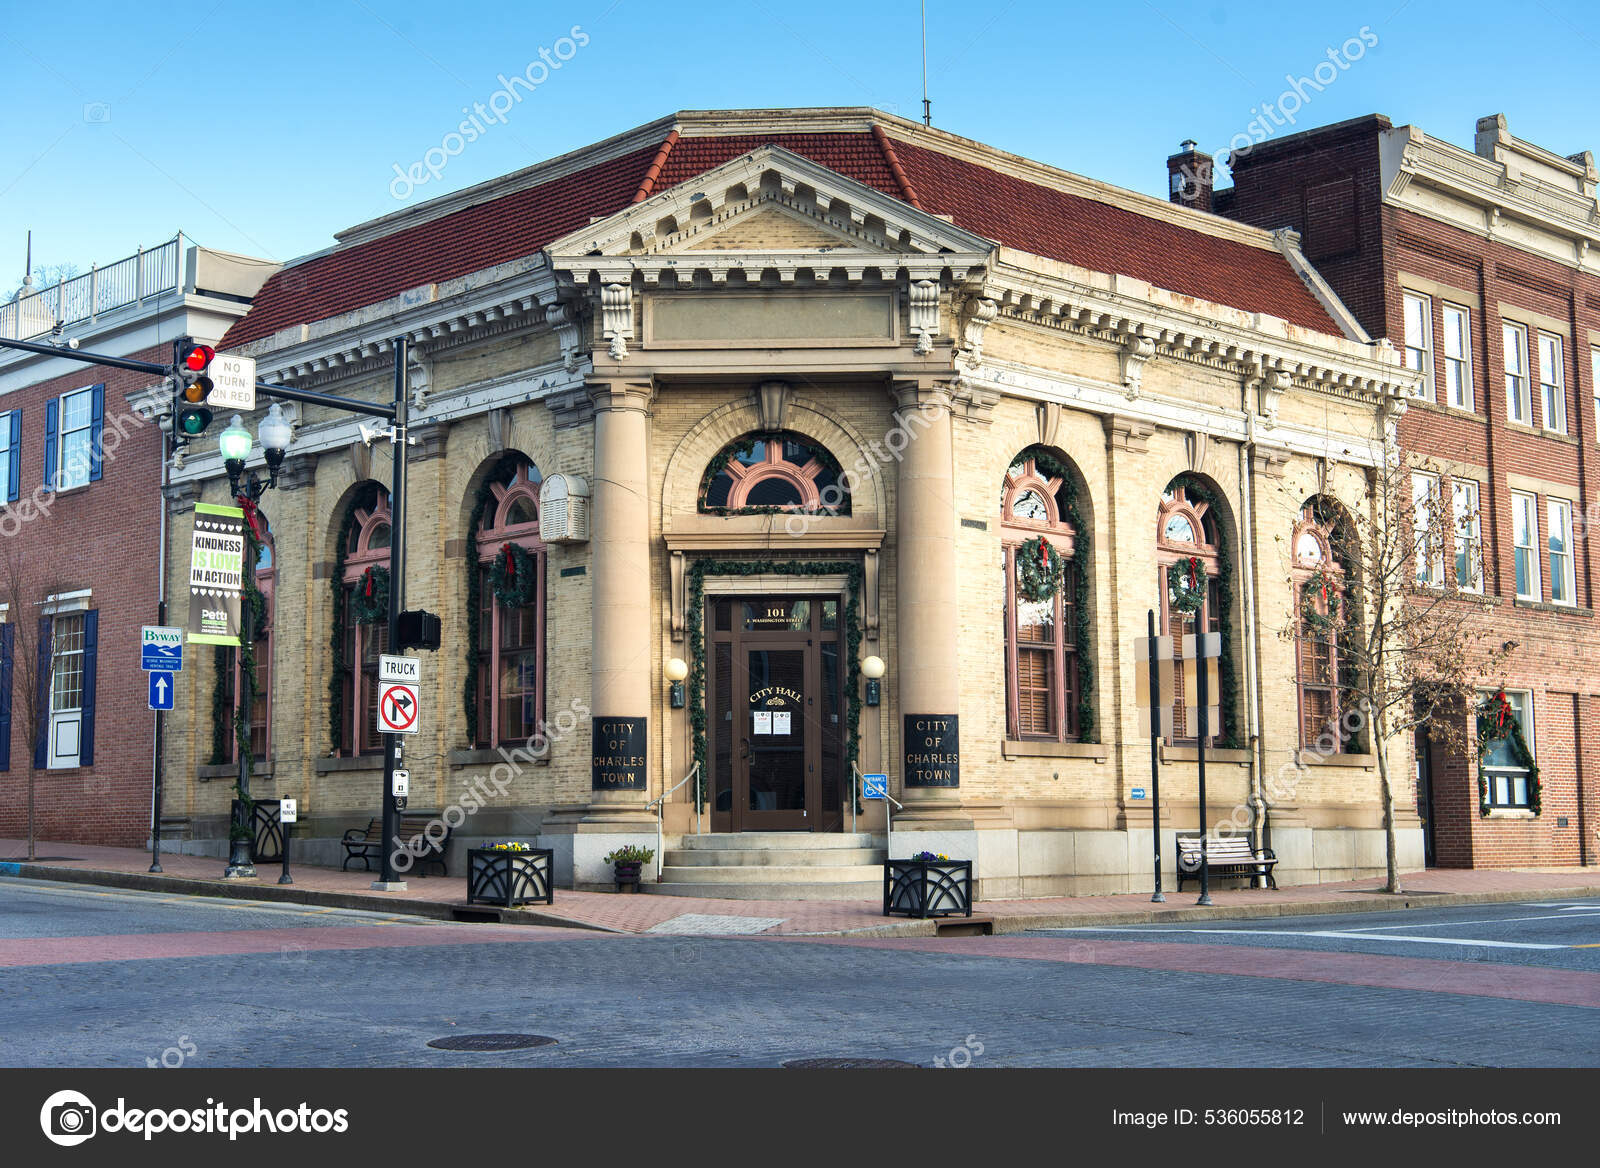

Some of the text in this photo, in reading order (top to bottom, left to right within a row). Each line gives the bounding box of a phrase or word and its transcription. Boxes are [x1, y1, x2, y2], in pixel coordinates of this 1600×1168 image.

[223, 361, 241, 373] NO
[218, 375, 246, 388] TURN
[212, 389, 251, 403] ON RED
[195, 536, 241, 552] KINDNESS
[193, 549, 241, 571] IS LOVE
[192, 569, 240, 585] IN ACTION
[767, 608, 785, 617] 101
[145, 630, 180, 642] BYWAY
[385, 661, 416, 675] TRUCK
[750, 686, 801, 703] CITY HALL
[602, 723, 634, 734] CITY
[916, 720, 948, 731] CITY
[609, 740, 627, 752] OF
[925, 737, 942, 748] OF
[593, 756, 644, 767] CHARLES
[907, 753, 958, 764] CHARLES
[601, 772, 635, 783] TOWN
[916, 769, 951, 780] TOWN
